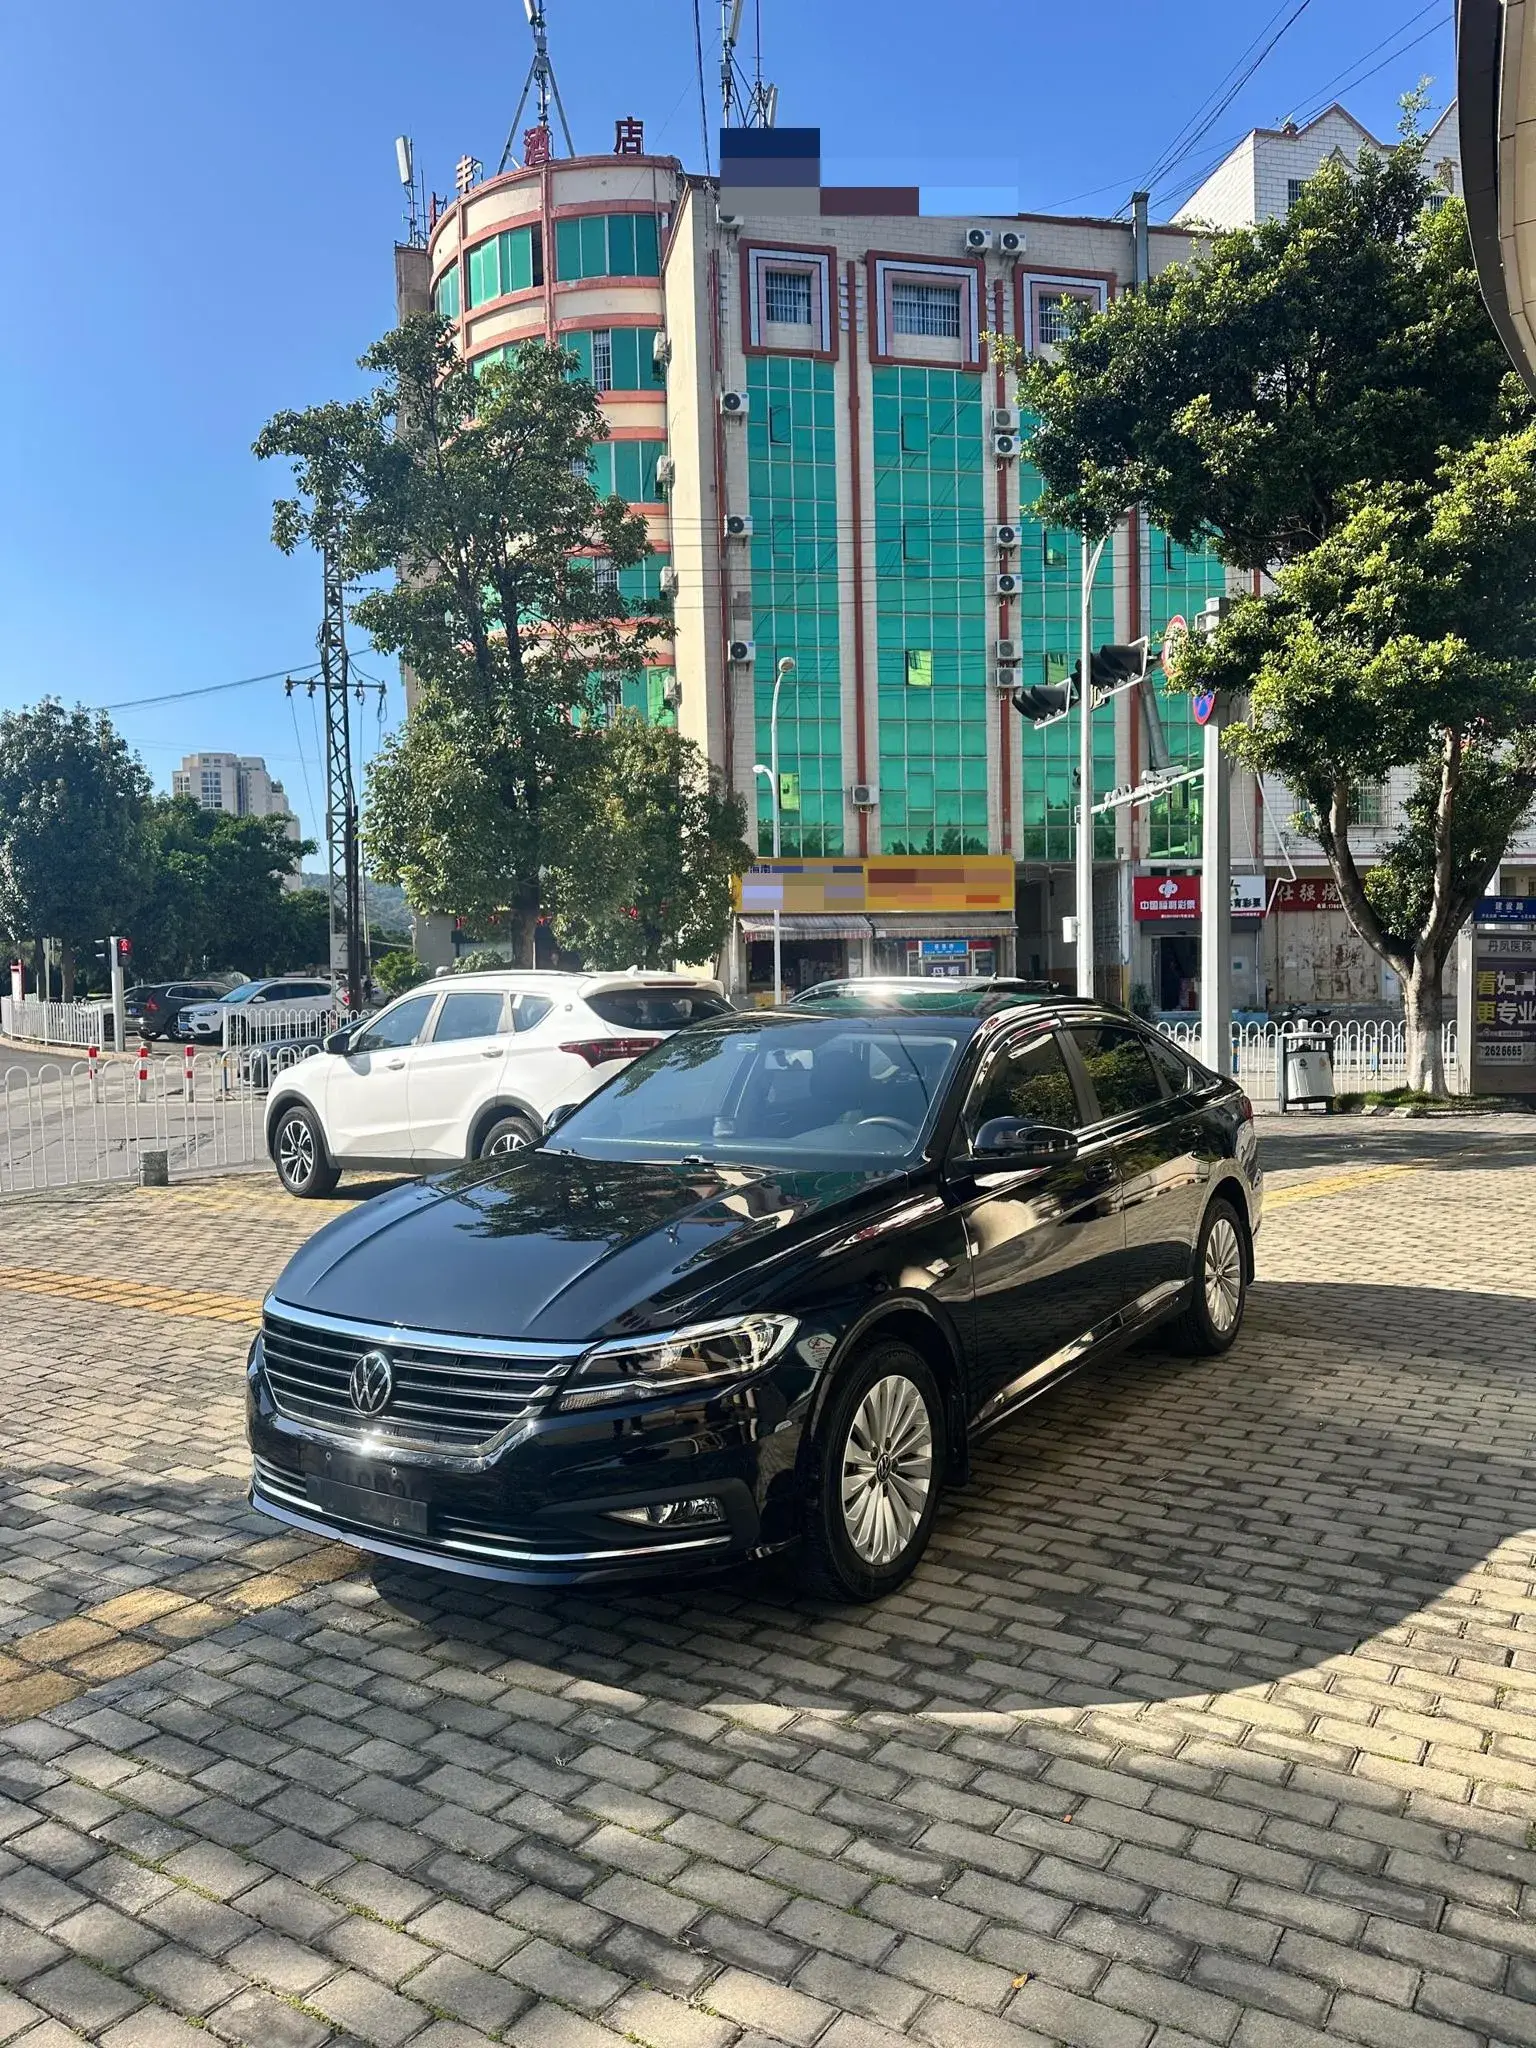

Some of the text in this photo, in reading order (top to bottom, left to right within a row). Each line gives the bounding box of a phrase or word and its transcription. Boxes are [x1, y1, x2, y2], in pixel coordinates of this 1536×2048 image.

[1230, 898, 1261, 908] 育彩票
[1488, 940, 1533, 952] 丹凤医院
[1476, 1000, 1536, 1025] 更专业
